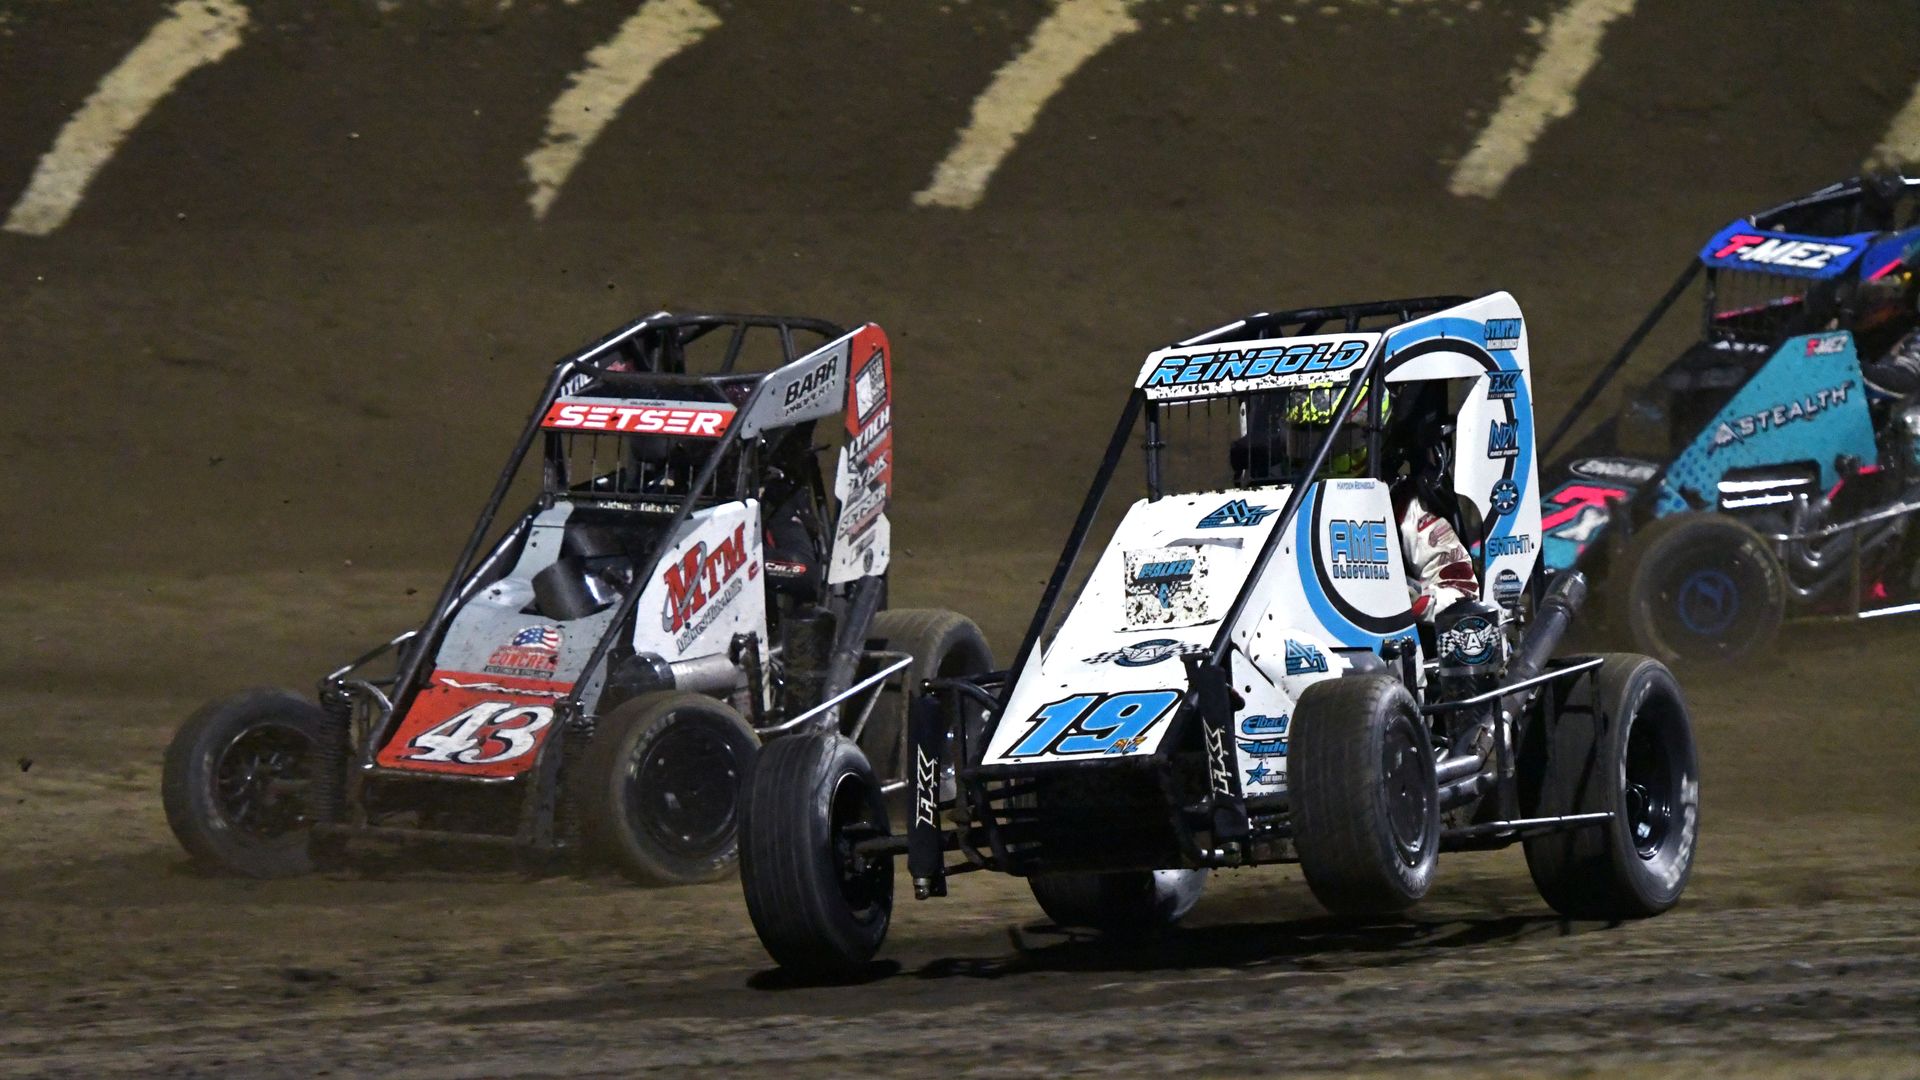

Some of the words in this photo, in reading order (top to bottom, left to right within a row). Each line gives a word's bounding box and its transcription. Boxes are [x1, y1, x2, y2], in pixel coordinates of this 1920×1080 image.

[784, 355, 838, 407] BARR
[1147, 340, 1369, 386] REINBOLD
[555, 406, 724, 434] SETSER
[850, 405, 890, 459] LYNCH
[1329, 518, 1390, 565] AME
[663, 522, 747, 636] MTM
[1332, 564, 1390, 580] ELECTRICAL
[404, 701, 554, 764] 43
[998, 688, 1187, 759] 19
